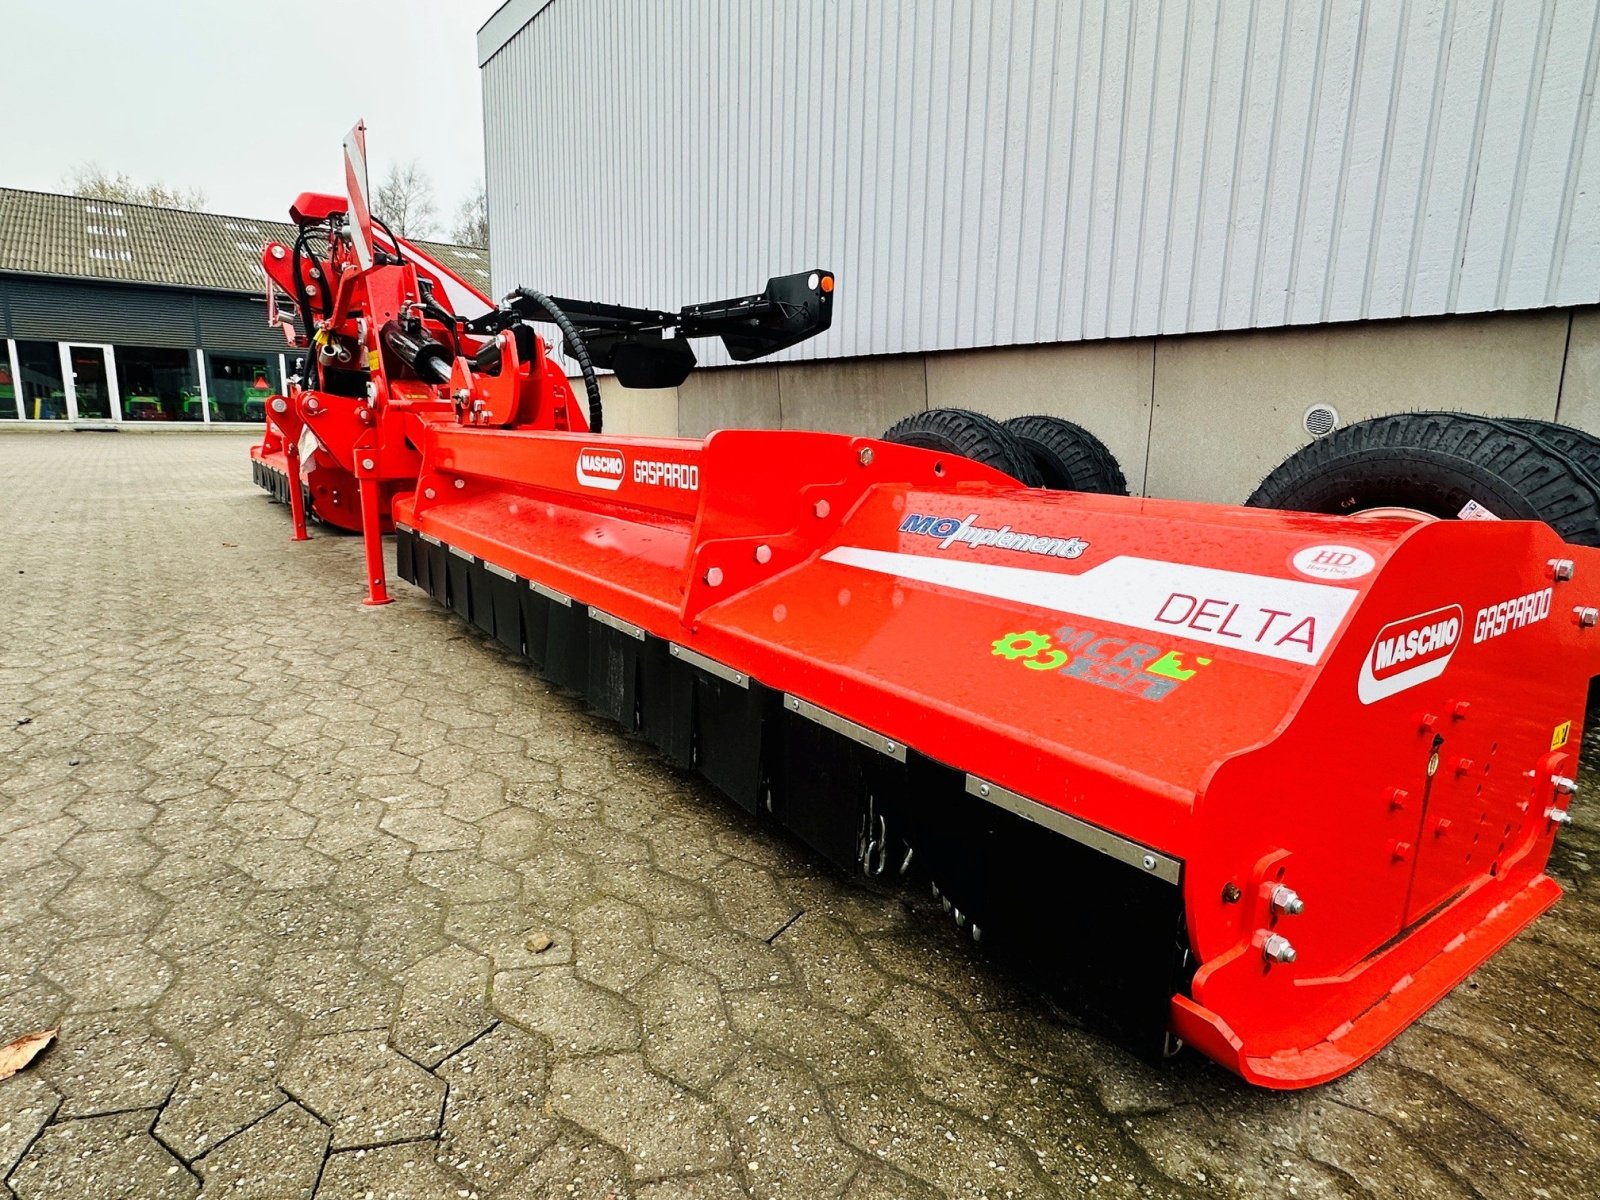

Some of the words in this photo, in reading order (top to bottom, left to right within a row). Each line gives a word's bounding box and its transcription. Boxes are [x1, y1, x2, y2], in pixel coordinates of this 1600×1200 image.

[582, 455, 623, 475] MASCHIO
[633, 459, 699, 491] GASPARDO
[1312, 550, 1357, 566] HD
[1154, 592, 1316, 653] DELTA
[1375, 617, 1459, 671] MASCHIO
[1473, 587, 1553, 645] GASPARDO
